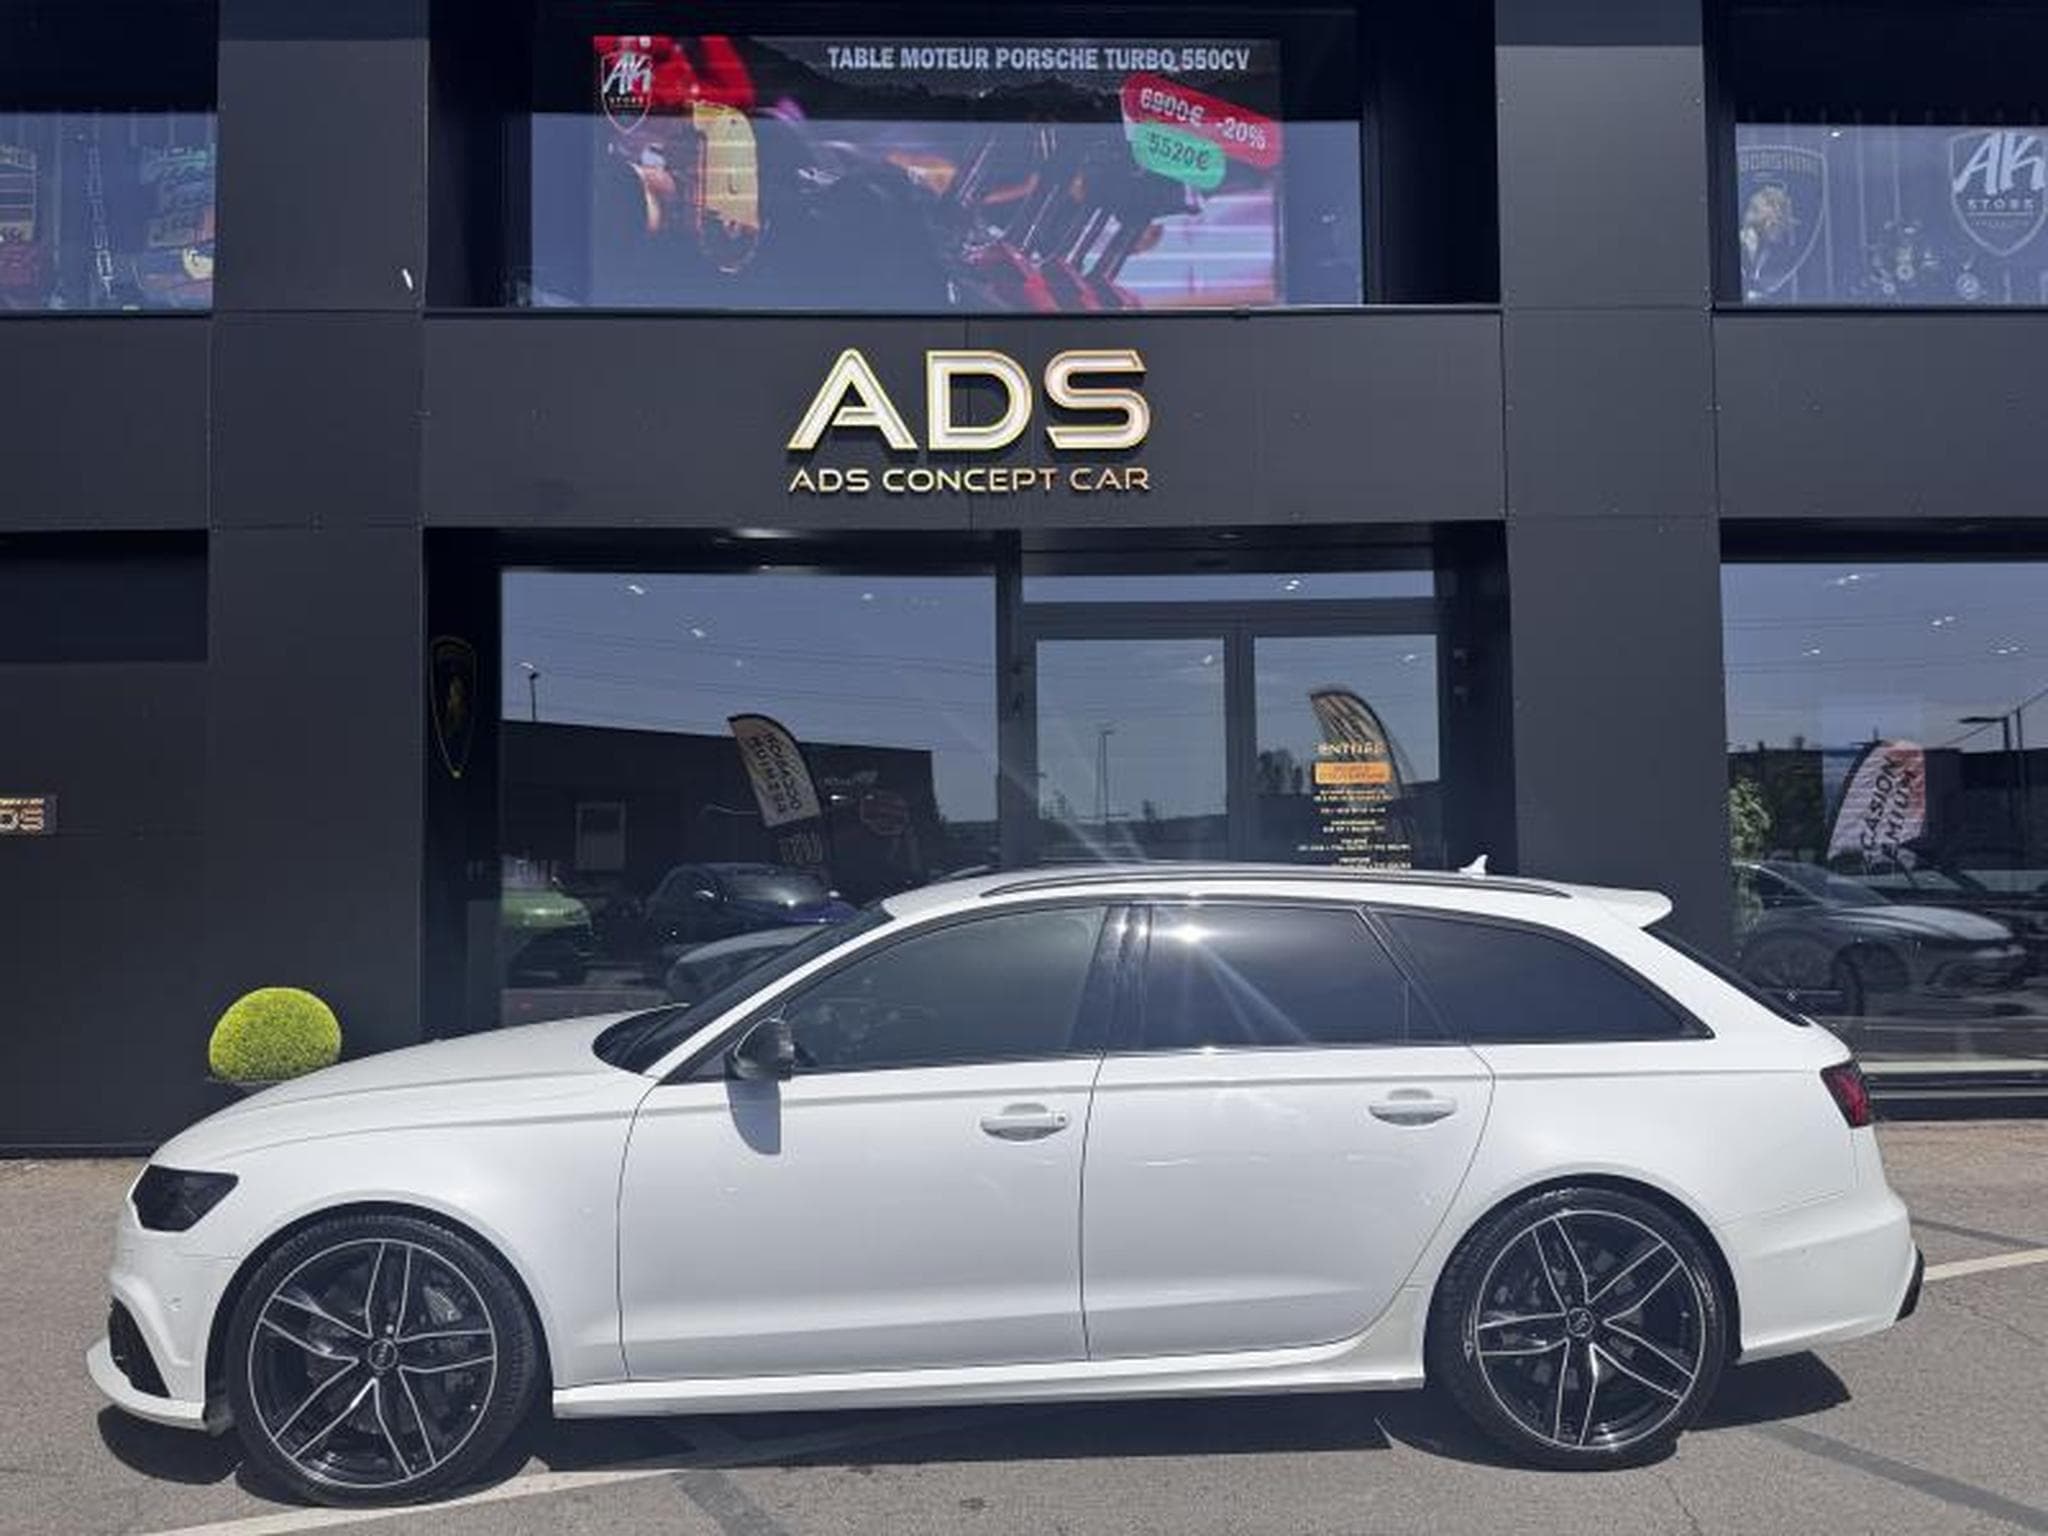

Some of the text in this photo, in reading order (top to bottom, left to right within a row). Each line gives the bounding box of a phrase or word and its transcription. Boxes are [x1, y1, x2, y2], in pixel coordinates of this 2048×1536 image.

[827, 47, 895, 70] TABLE
[900, 47, 989, 70] MOTEUR
[995, 47, 1098, 70] PORSCHE
[1181, 48, 1250, 70] 550CV
[1145, 130, 1211, 172] 5520€
[1215, 116, 1267, 151] -20%
[787, 348, 1151, 451] ADS
[788, 467, 1151, 493] ADS CONCEPT CAR
